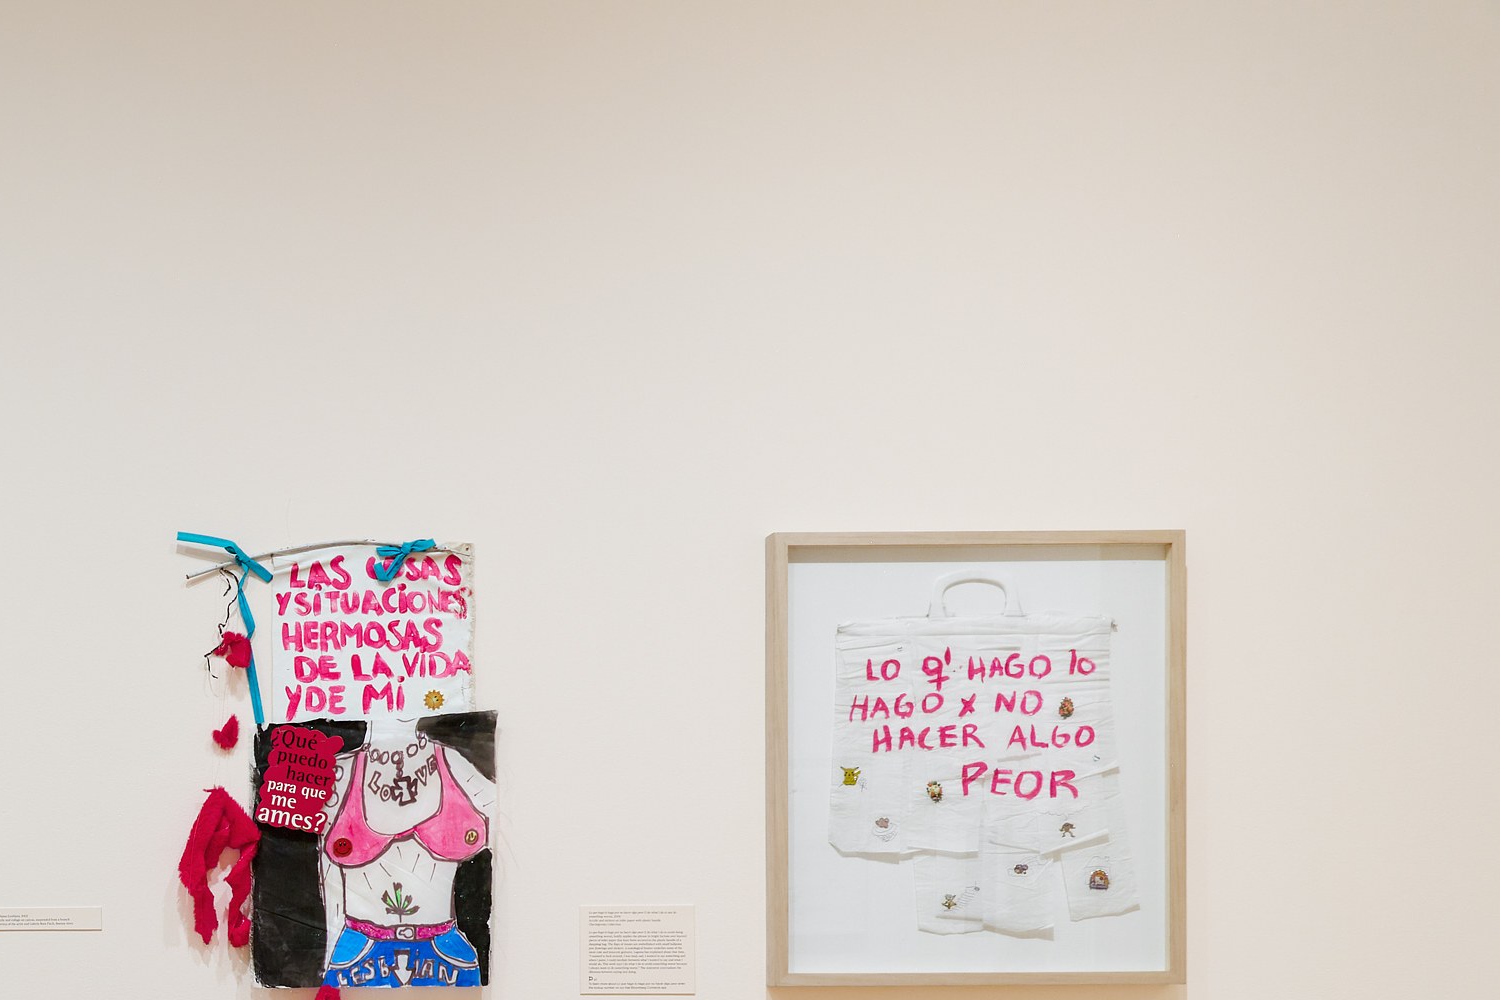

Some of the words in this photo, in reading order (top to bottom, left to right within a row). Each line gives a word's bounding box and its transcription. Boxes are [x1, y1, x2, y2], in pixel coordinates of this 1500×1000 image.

[290, 555, 351, 590] LAS
[281, 617, 444, 652] HERMOSAS
[294, 655, 341, 683] DE
[351, 652, 394, 681] LA
[866, 659, 901, 681] LO
[968, 653, 1051, 683] HAGO
[849, 692, 944, 722] HAGO
[994, 690, 1043, 716] NO
[272, 729, 318, 750] ¿Qué
[872, 724, 986, 753] HACER
[1007, 725, 1095, 751] ALGO
[277, 751, 328, 770] puedo
[267, 780, 297, 794] para
[301, 786, 327, 800] que
[286, 766, 331, 787] hacer
[961, 761, 1079, 800] PEOR
[271, 794, 297, 809] me
[257, 807, 327, 832] ames?
